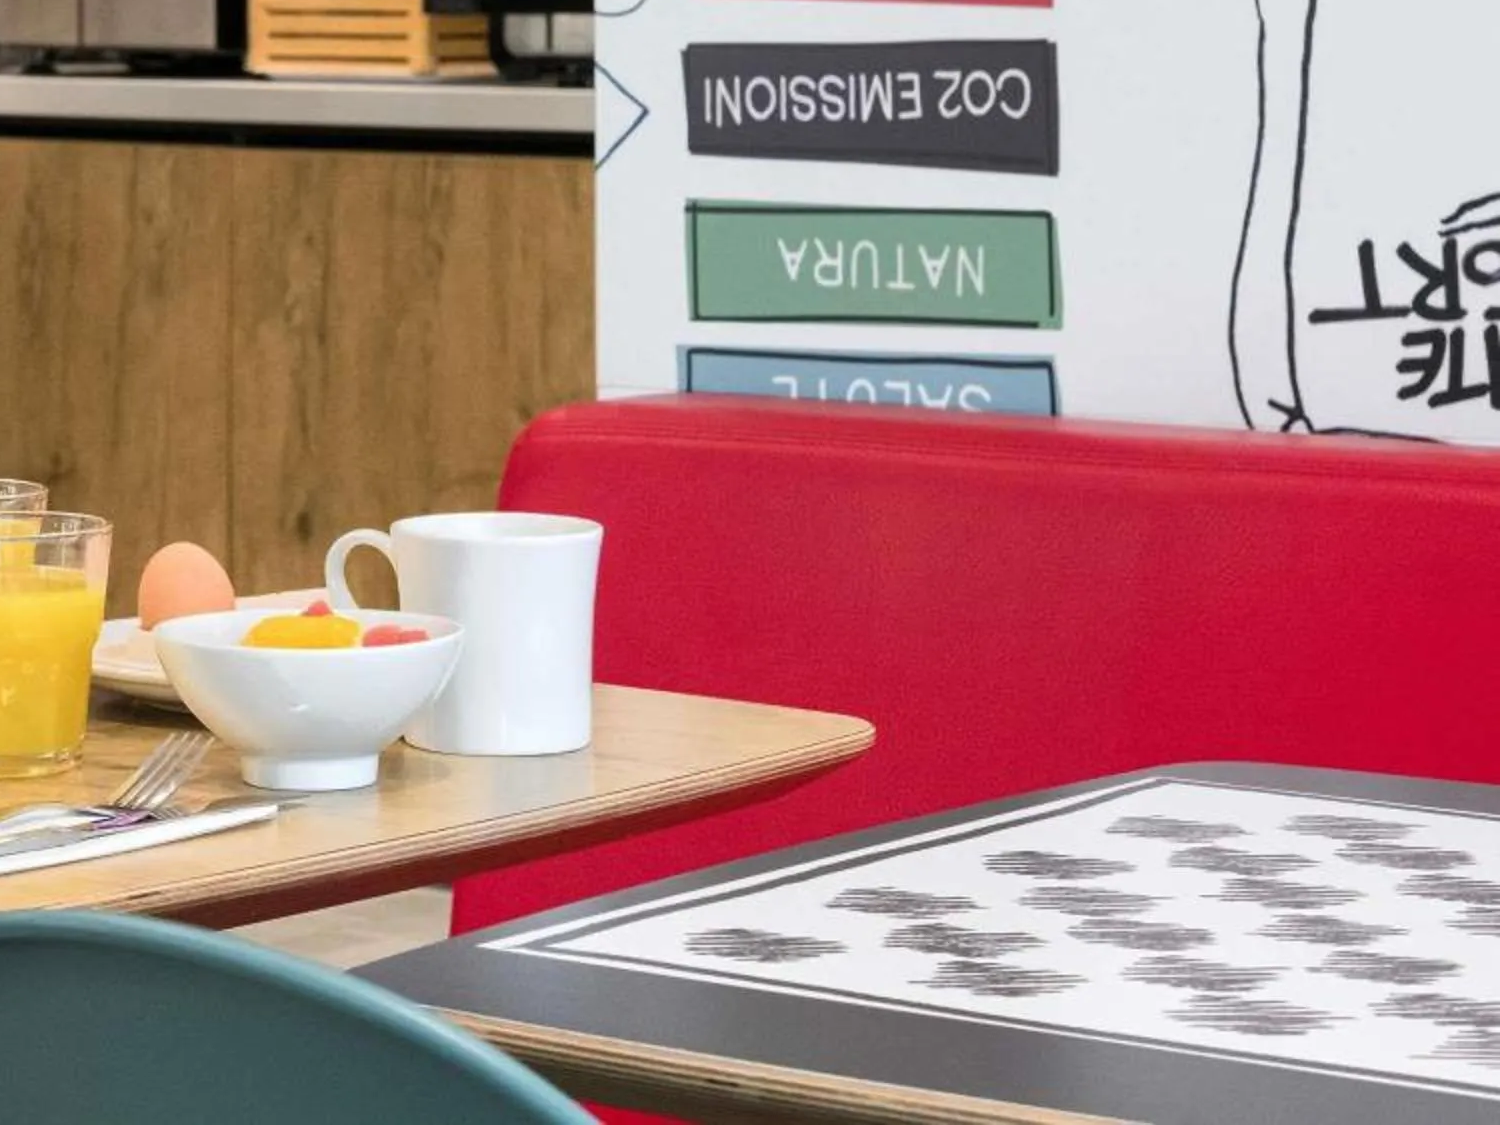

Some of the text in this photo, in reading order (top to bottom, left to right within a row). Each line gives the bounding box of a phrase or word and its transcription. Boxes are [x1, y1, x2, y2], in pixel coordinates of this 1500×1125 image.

[703, 68, 1032, 128] CO2 EMISSIONI
[776, 237, 985, 298] NATURA
